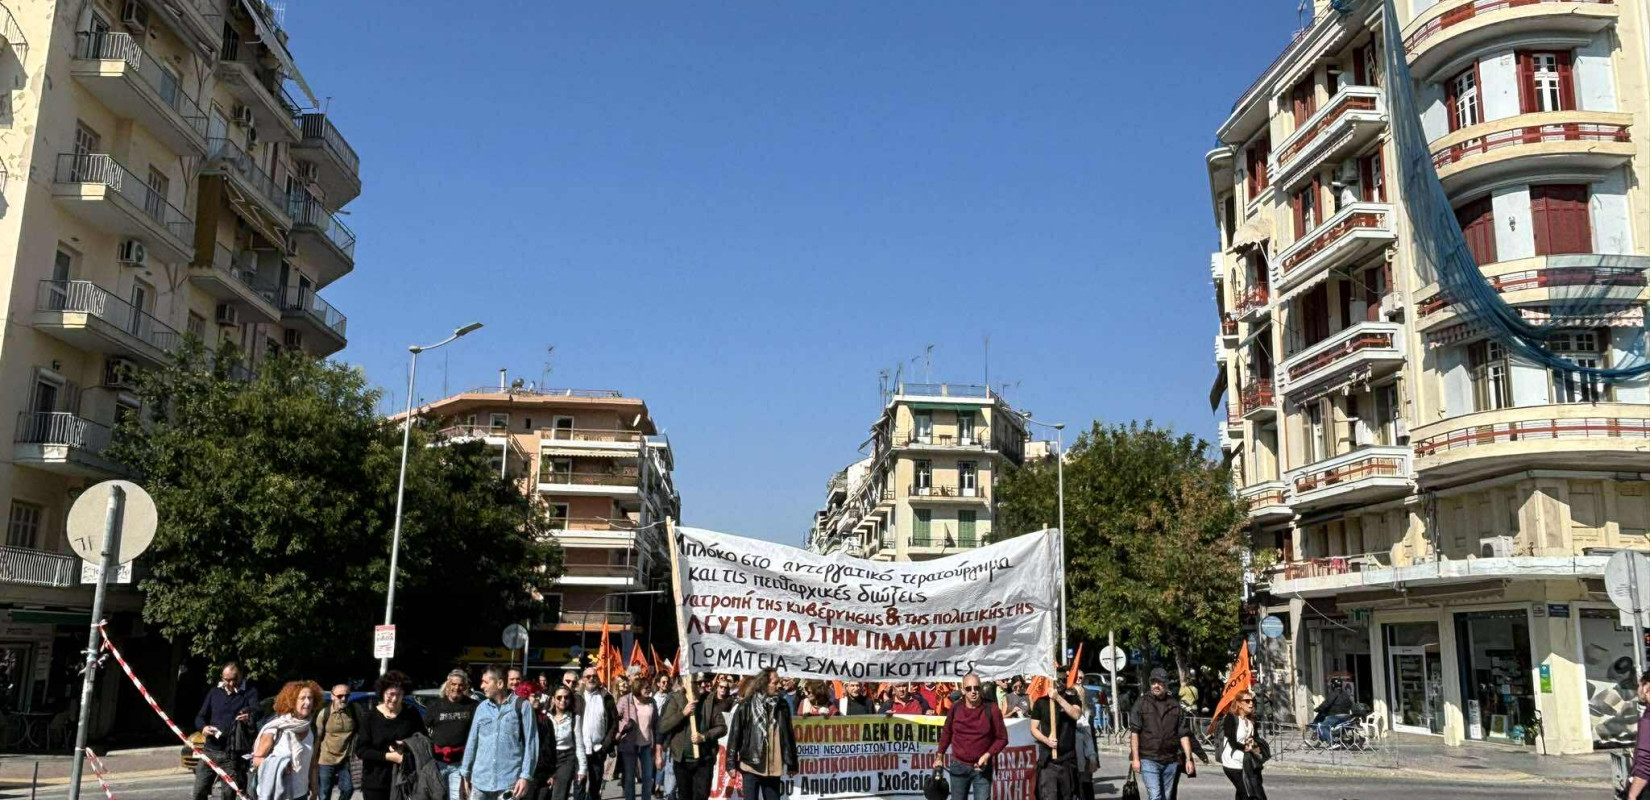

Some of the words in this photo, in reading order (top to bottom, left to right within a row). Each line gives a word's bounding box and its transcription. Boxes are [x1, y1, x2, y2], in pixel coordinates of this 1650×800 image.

[688, 567, 719, 581] και
[723, 569, 748, 584] τις
[754, 575, 851, 600] πειθαρχικές
[682, 590, 755, 613] νατροπή
[886, 607, 901, 626] &
[687, 614, 802, 643] ΛΕΥΤΕΡΙΑ
[806, 621, 860, 647] ΣΤΗΝ
[865, 625, 998, 651] ΠΑΛΑΙΣΤΙΝΗ
[794, 724, 860, 742] ΟΛΟΓΗΣΗ
[862, 723, 889, 741] ΔΕΝ
[893, 723, 913, 742] ΘΑ
[994, 750, 1034, 769] ΩΝΑΣ
[800, 774, 872, 797] Δημόσιου
